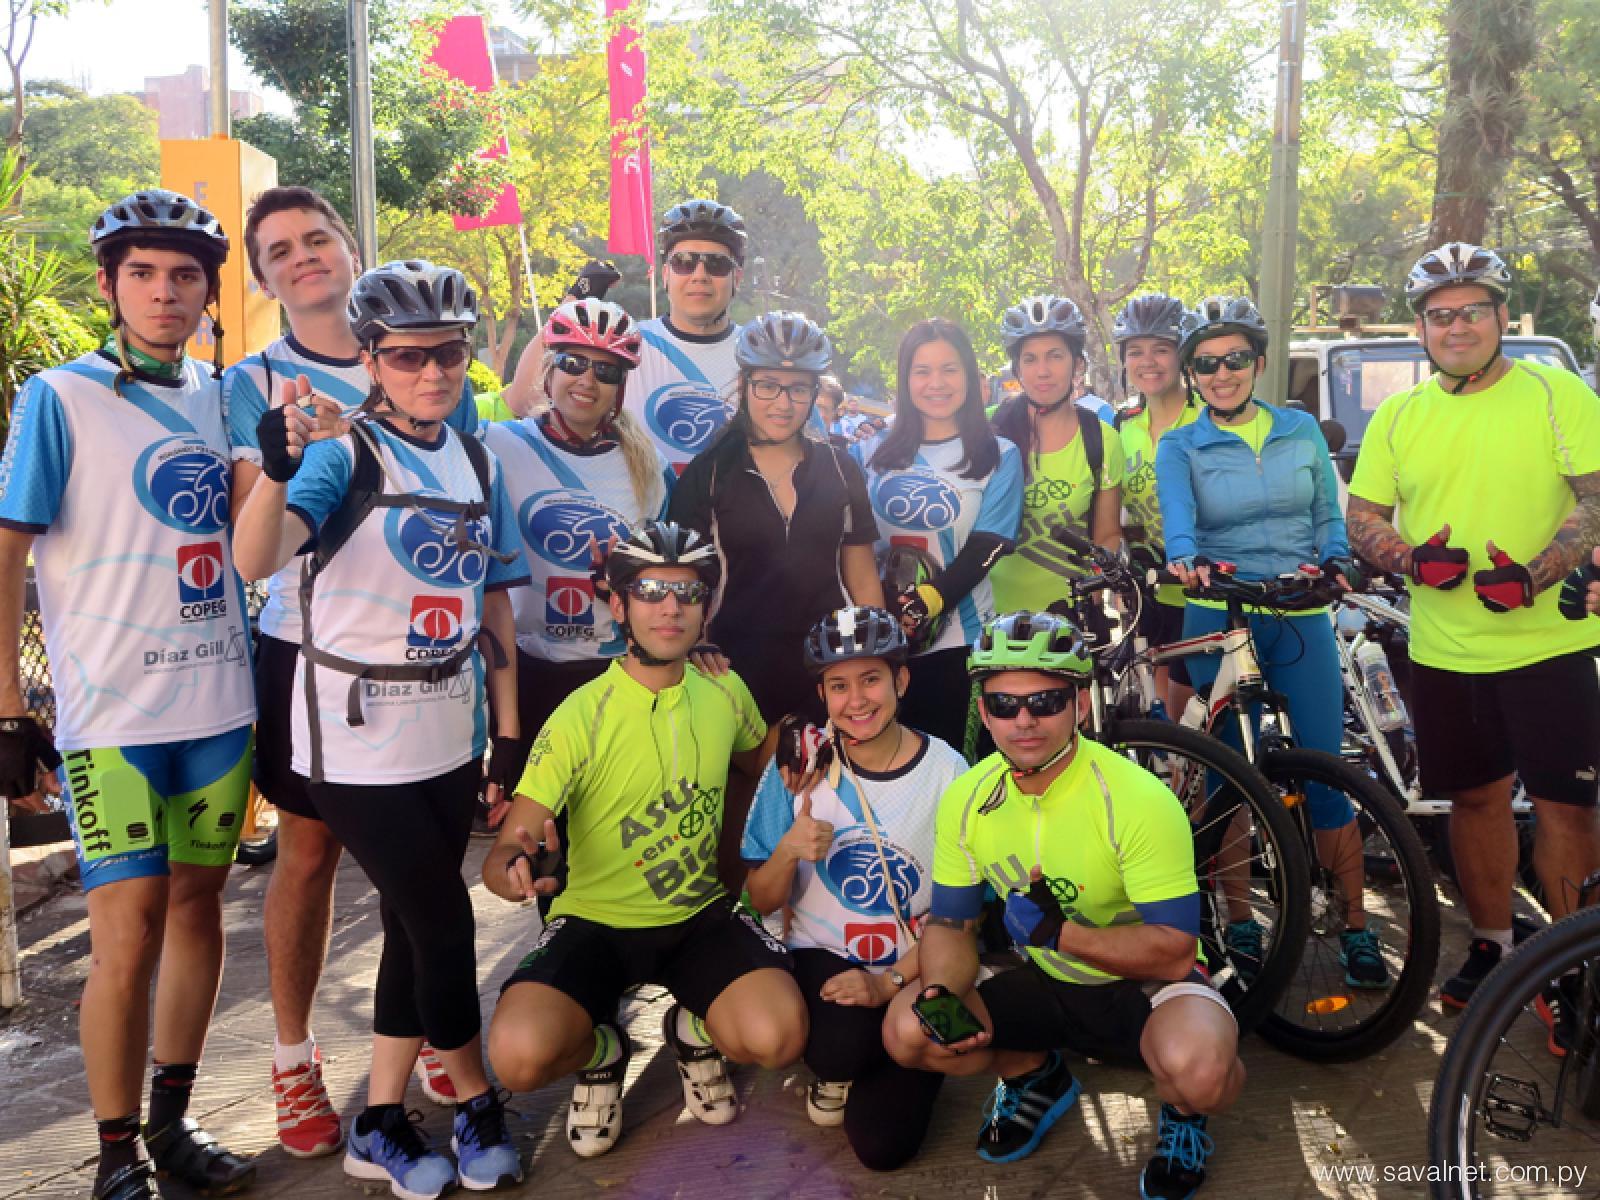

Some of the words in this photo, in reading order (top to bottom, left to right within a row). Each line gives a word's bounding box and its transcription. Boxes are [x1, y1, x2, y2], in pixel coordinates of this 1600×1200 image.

[180, 599, 227, 619] COPEG
[545, 624, 595, 638] COPEG
[67, 749, 112, 852] Tinkoff
[620, 776, 694, 850] ASU
